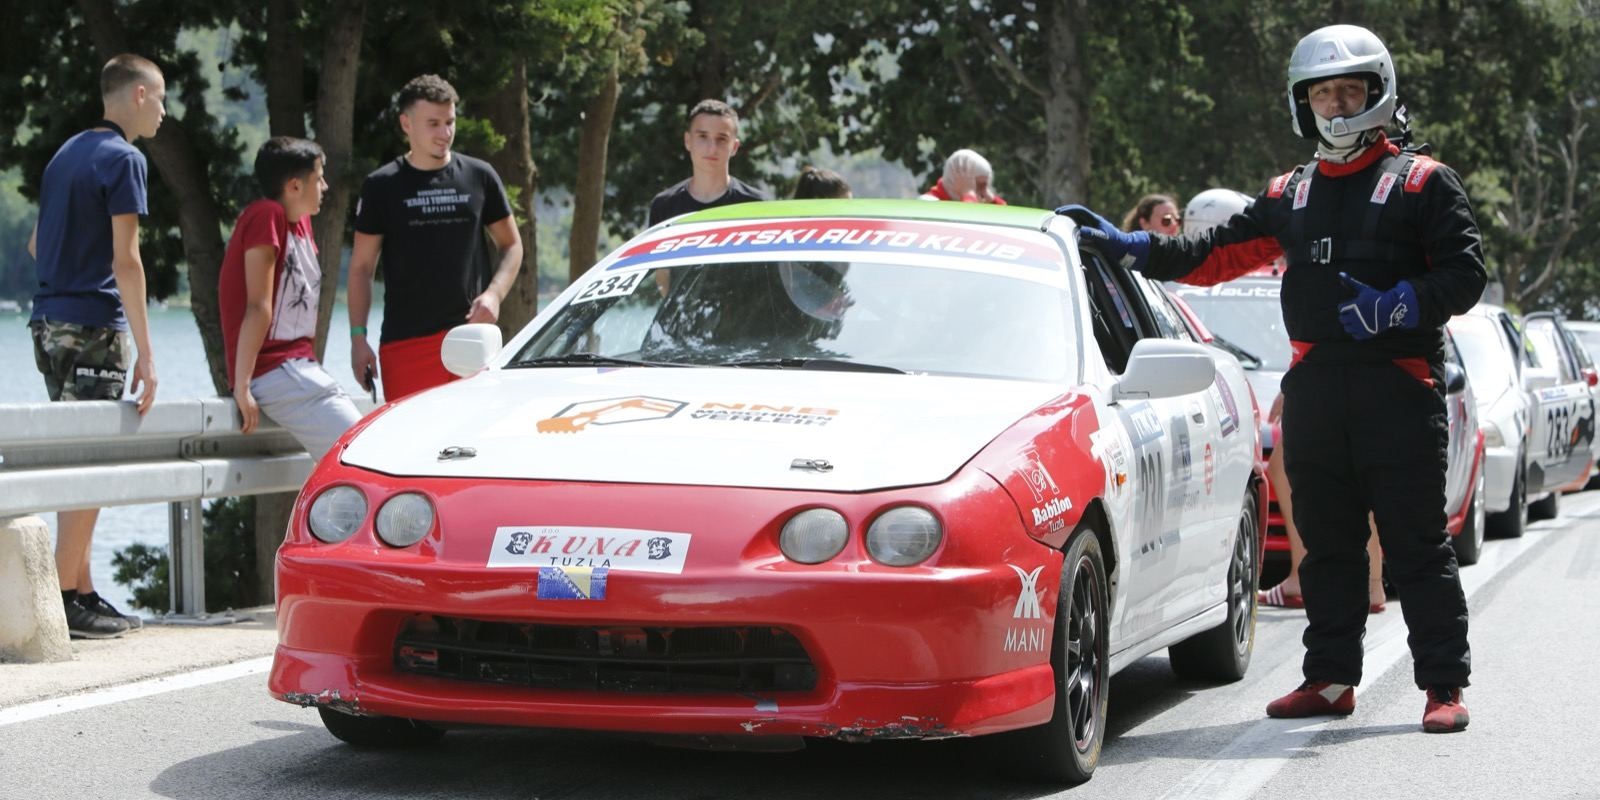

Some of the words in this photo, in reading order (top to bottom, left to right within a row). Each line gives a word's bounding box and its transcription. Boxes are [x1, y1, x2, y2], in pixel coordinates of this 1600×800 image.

[649, 228, 818, 254] SPLITSKI
[815, 228, 919, 248] AUTO
[918, 235, 1026, 261] KLUB
[579, 272, 640, 300] 234
[690, 412, 828, 427] VERLEIH
[695, 409, 833, 422] MASCHINEN
[1031, 496, 1073, 526] Babilon
[1048, 517, 1065, 533] Tuzla
[529, 534, 643, 557] KUNA
[549, 556, 612, 568] TUZLA
[1003, 626, 1045, 653] MANI
